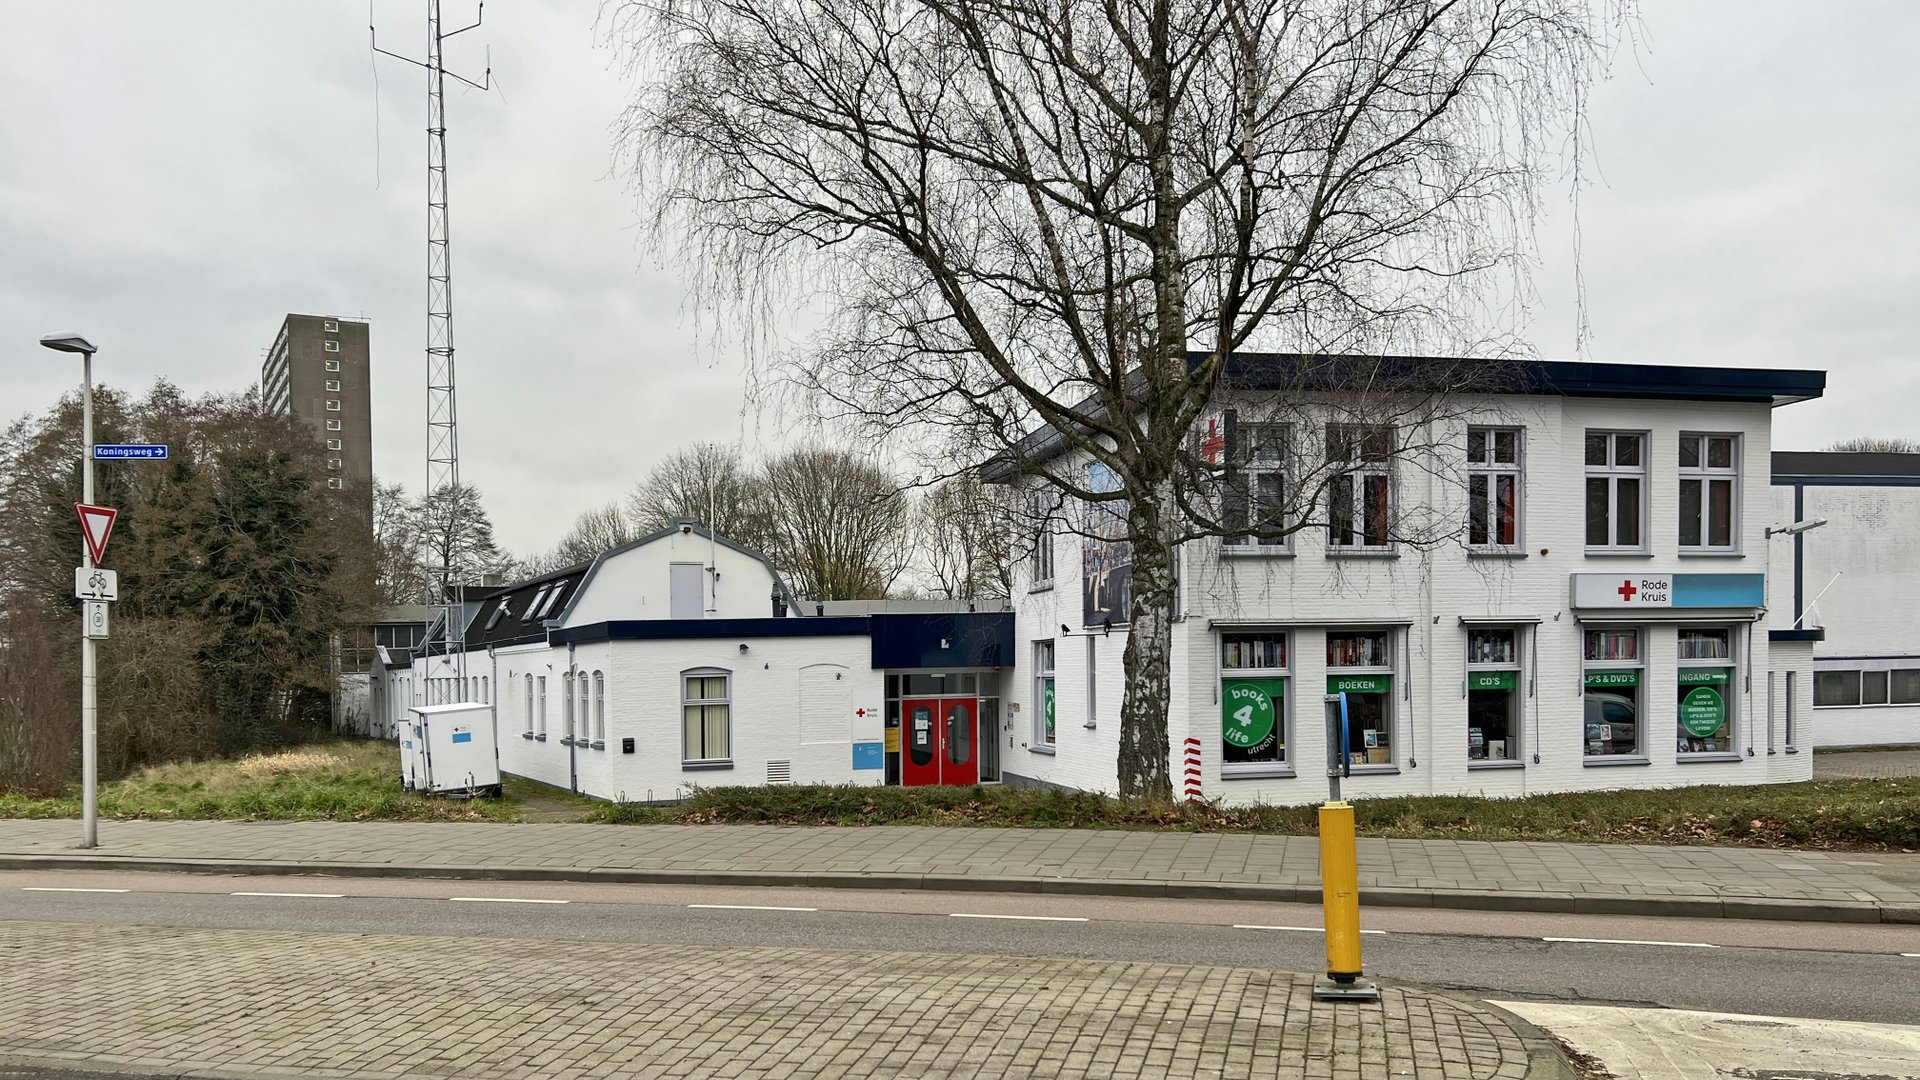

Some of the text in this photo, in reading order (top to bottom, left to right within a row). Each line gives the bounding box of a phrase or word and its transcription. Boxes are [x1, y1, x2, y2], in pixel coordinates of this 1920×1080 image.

[97, 447, 152, 457] Koningsweg
[1641, 579, 1668, 590] Rode
[1641, 592, 1667, 602] Kruis
[1480, 677, 1500, 686] CD'S
[1603, 675, 1609, 683] &
[1610, 674, 1636, 683] DVD'S
[1679, 673, 1711, 681] INGANG
[1338, 681, 1375, 689] BOEKEN
[1231, 688, 1268, 711] books
[1232, 704, 1254, 727] 4
[1225, 727, 1249, 743] life
[1247, 733, 1276, 755] utrecht
